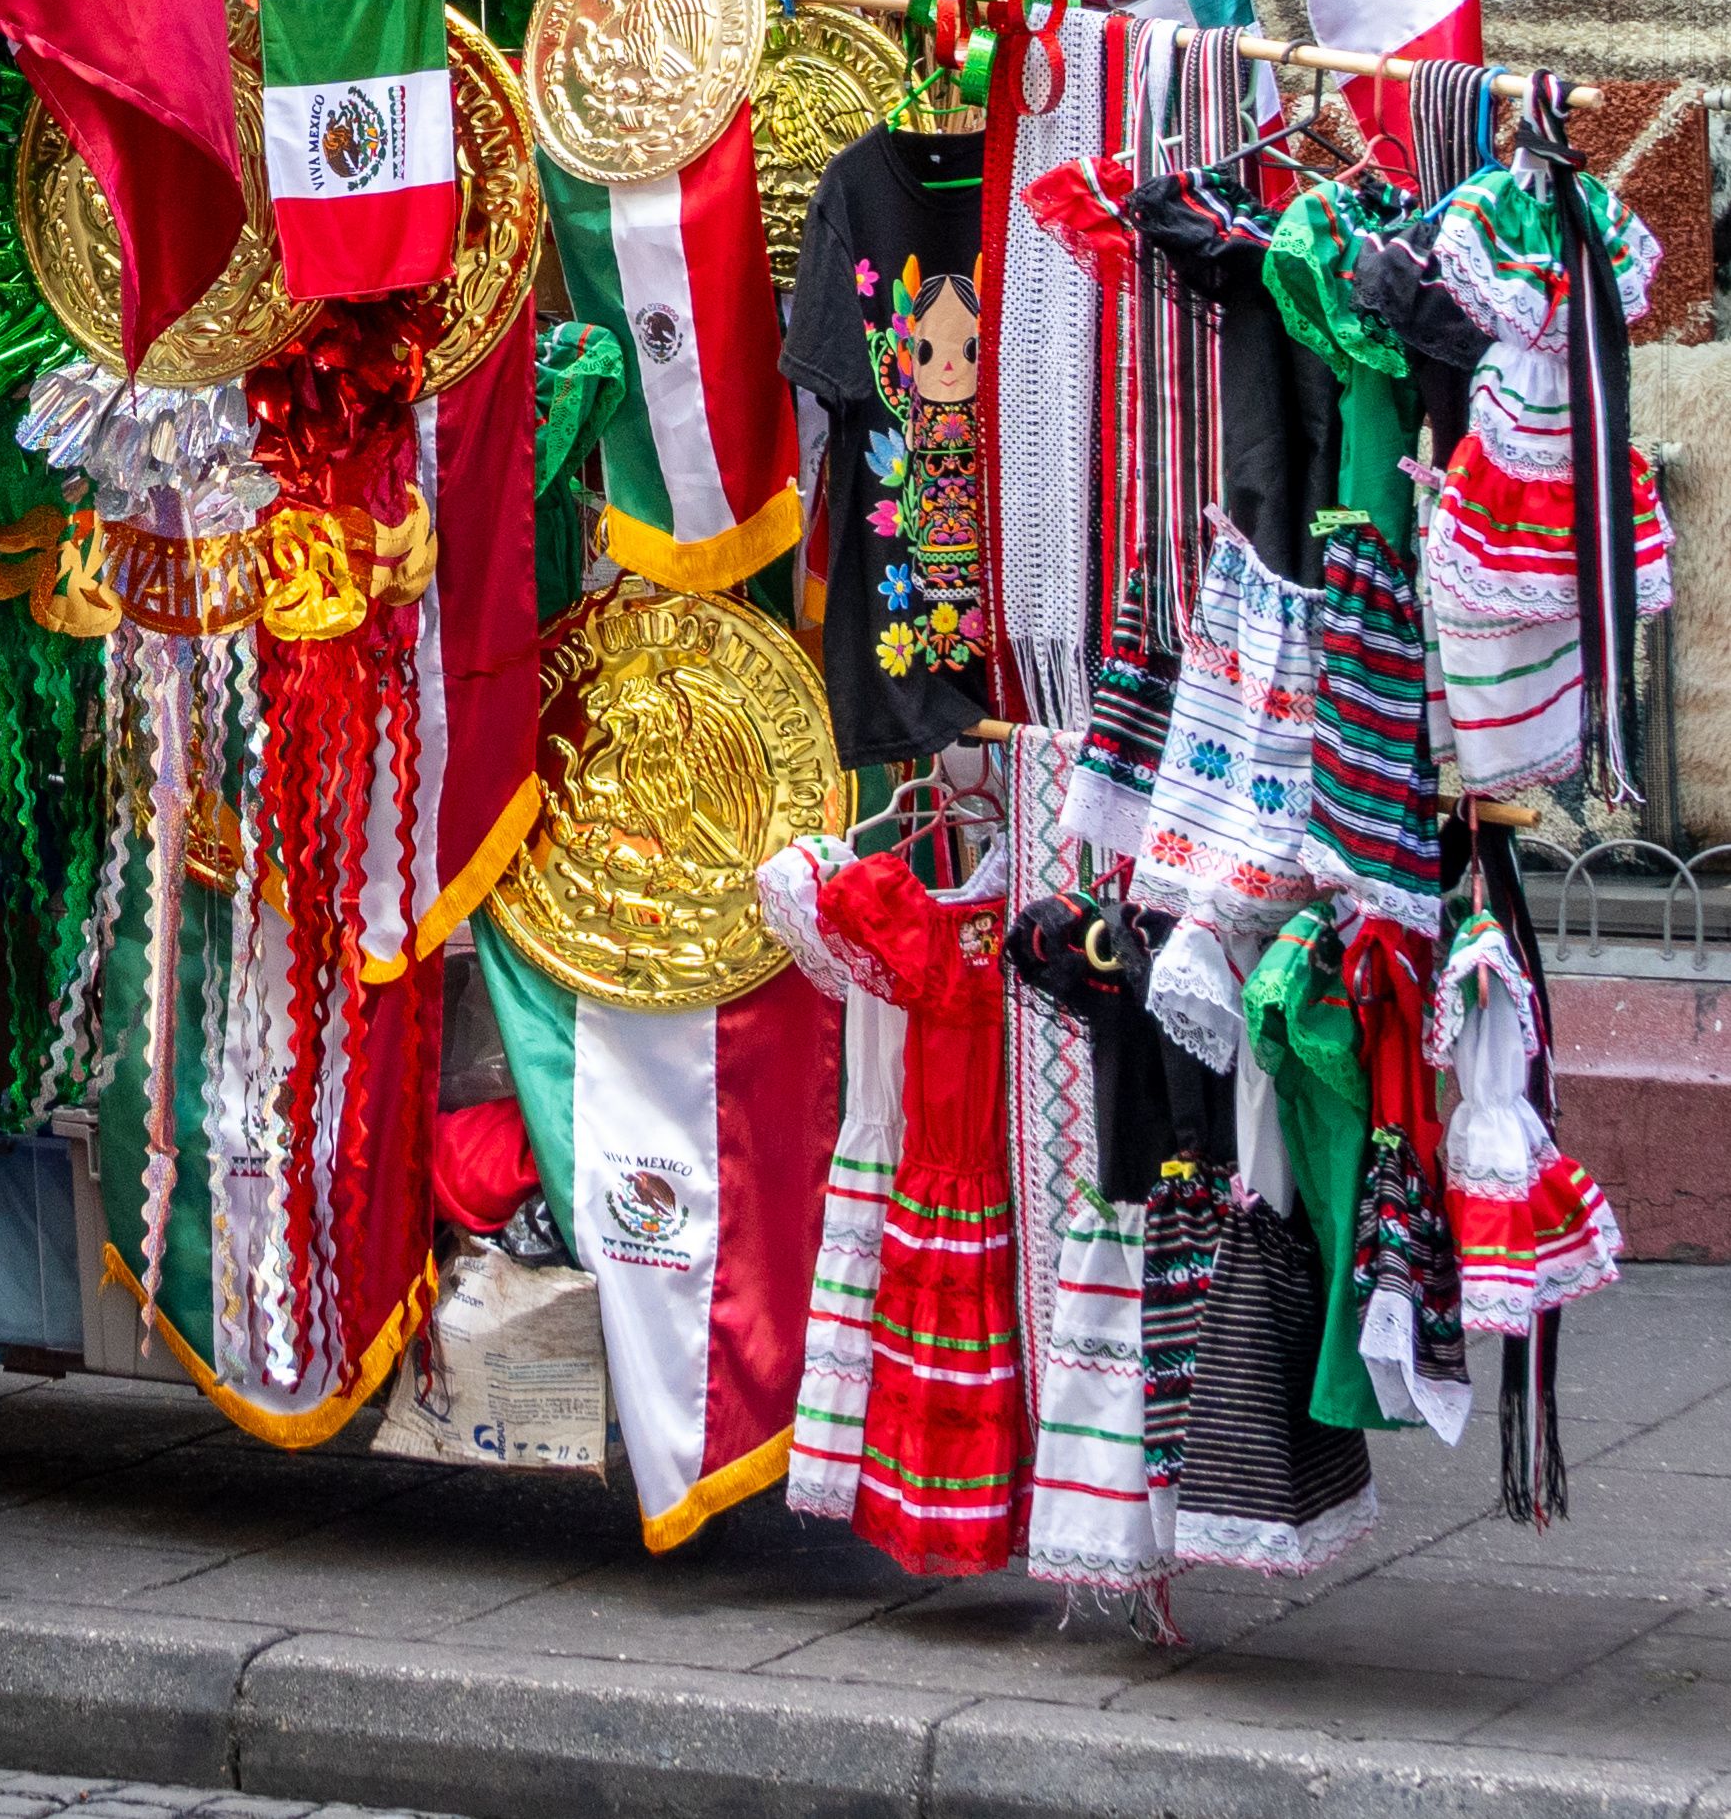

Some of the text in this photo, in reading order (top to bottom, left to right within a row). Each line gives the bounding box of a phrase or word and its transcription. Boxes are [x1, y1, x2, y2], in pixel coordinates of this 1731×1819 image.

[309, 94, 325, 191] VIVA MEXICO
[388, 85, 406, 181] MEXICO
[600, 610, 721, 656] UNIDOS
[717, 632, 825, 836] MEXICANOS
[635, 1156, 693, 1177] MEXICO
[601, 1235, 691, 1272] MEXICO
